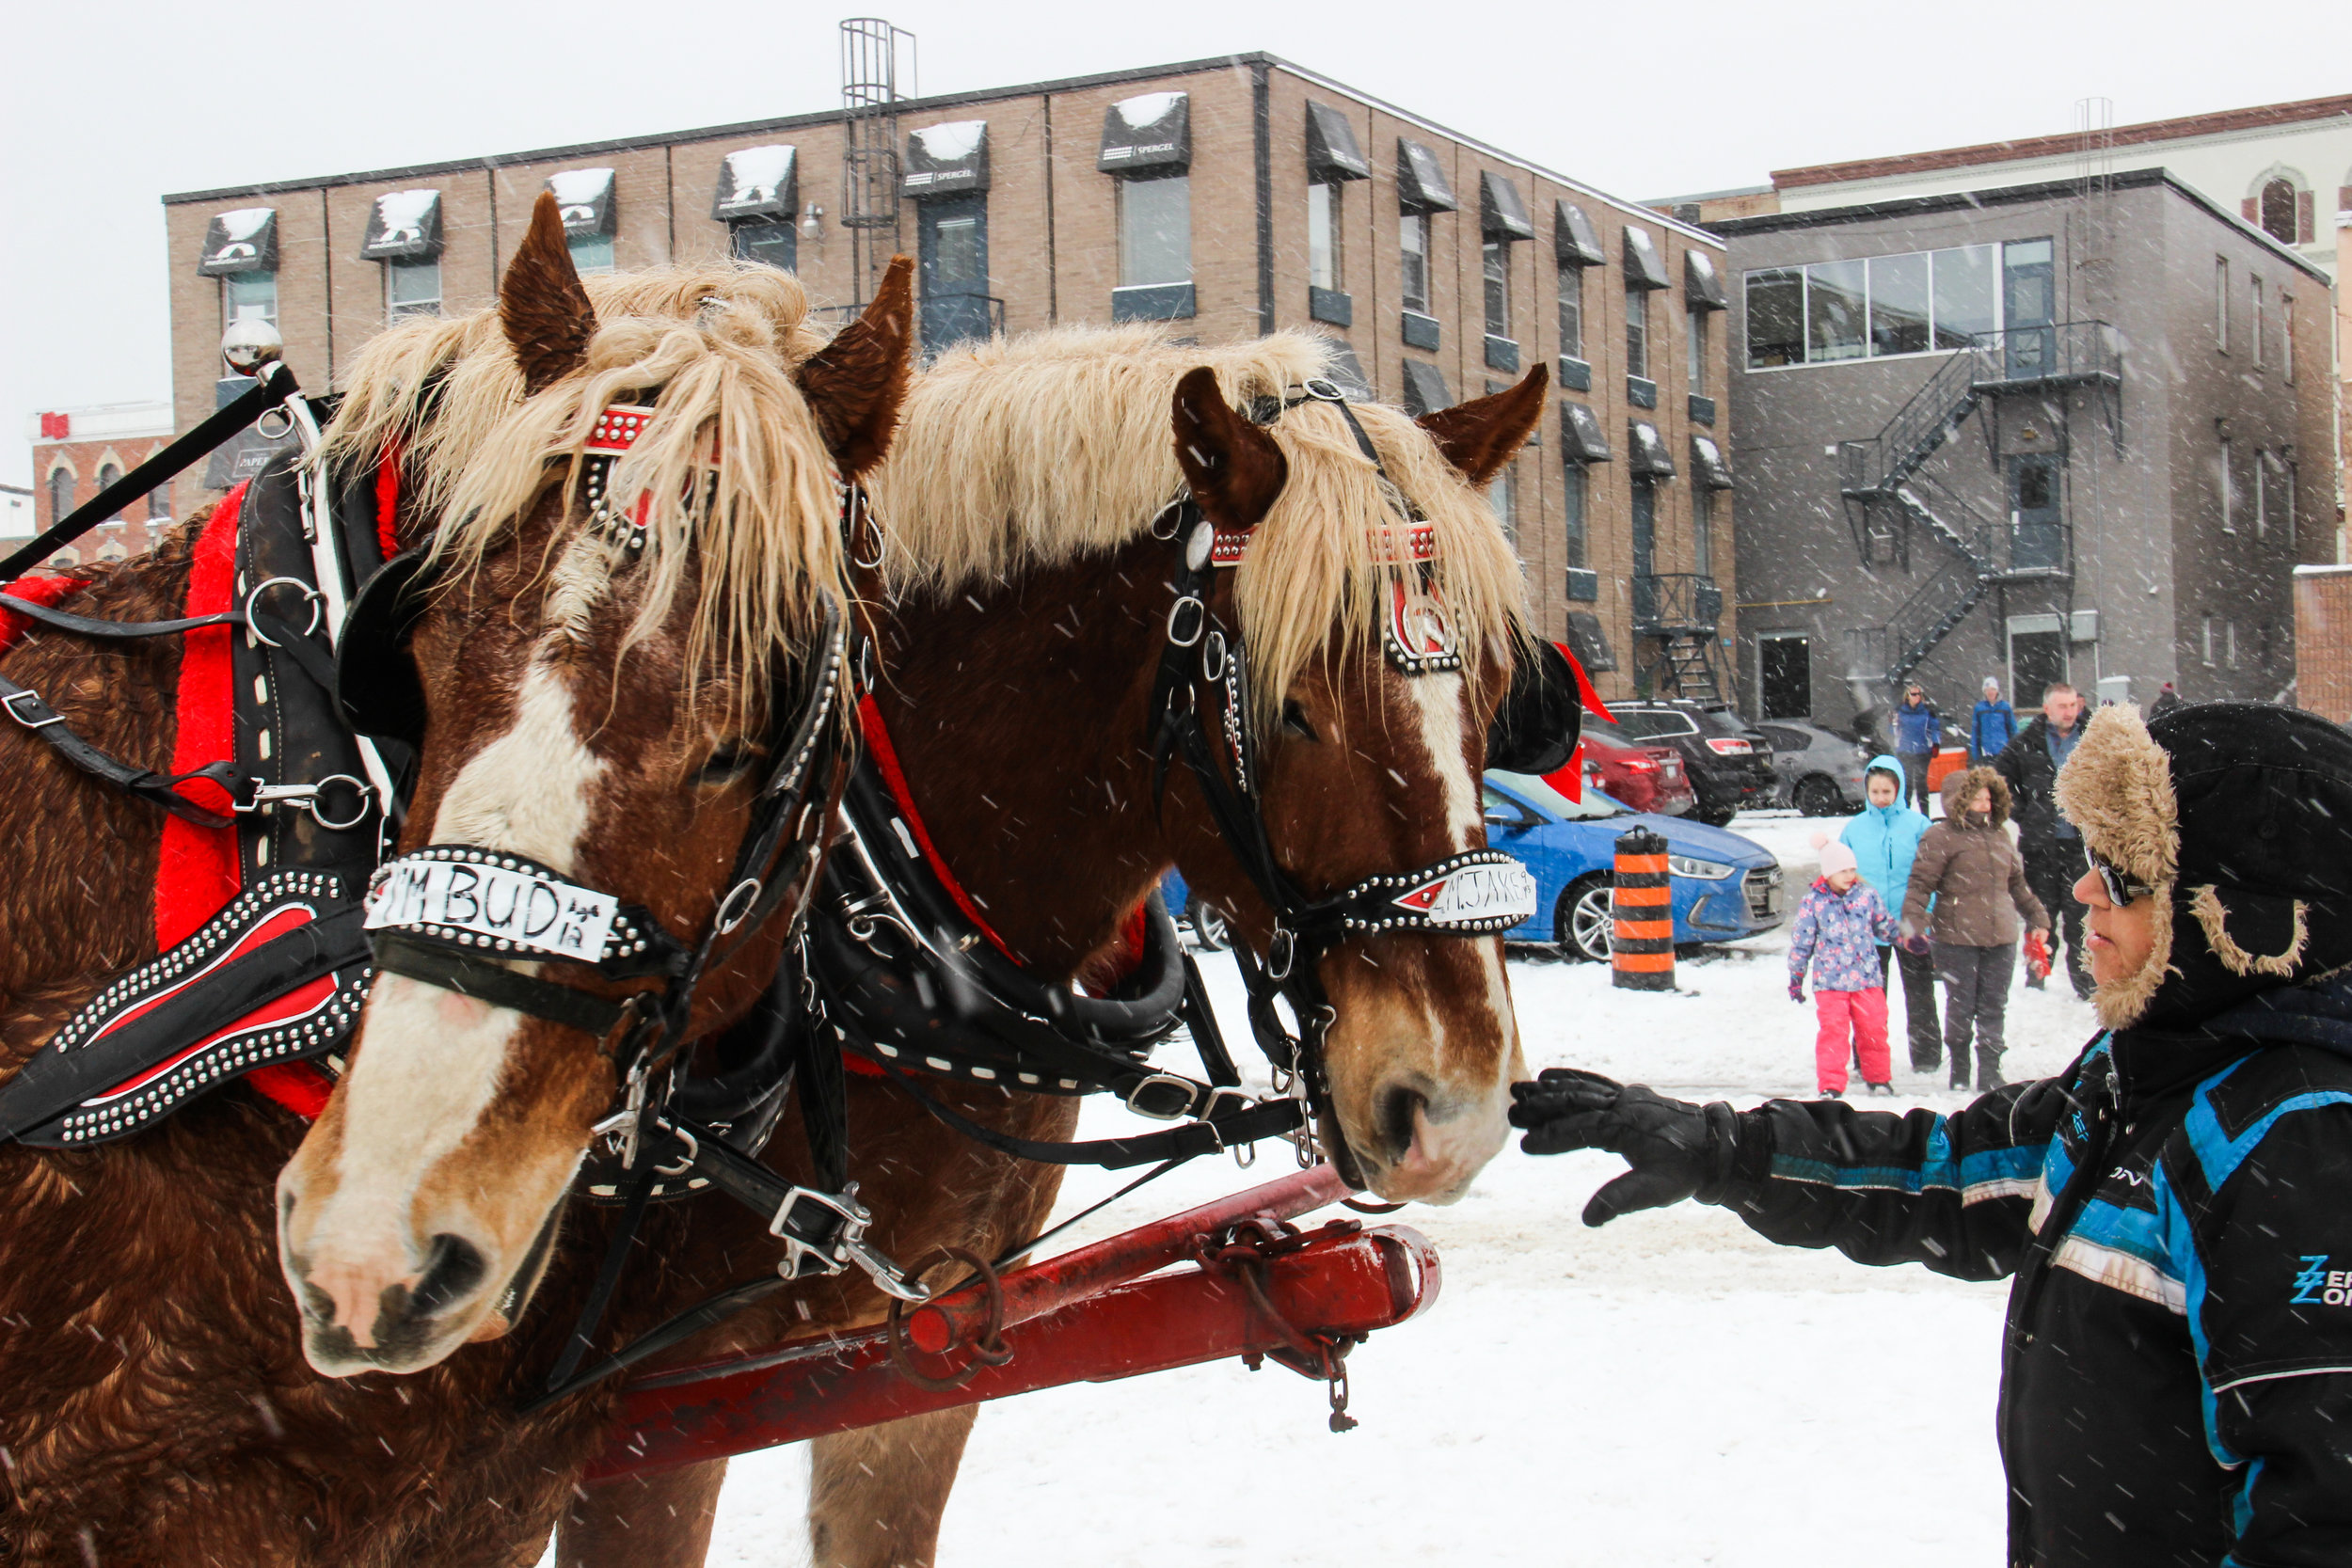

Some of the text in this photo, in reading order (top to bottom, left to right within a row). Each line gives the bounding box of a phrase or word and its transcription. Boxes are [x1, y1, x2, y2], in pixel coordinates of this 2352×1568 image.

[1137, 142, 1174, 154] SPERGEL
[937, 169, 972, 182] SPERGEL
[445, 864, 558, 938] BUD
[1464, 870, 1522, 908] JAKE
